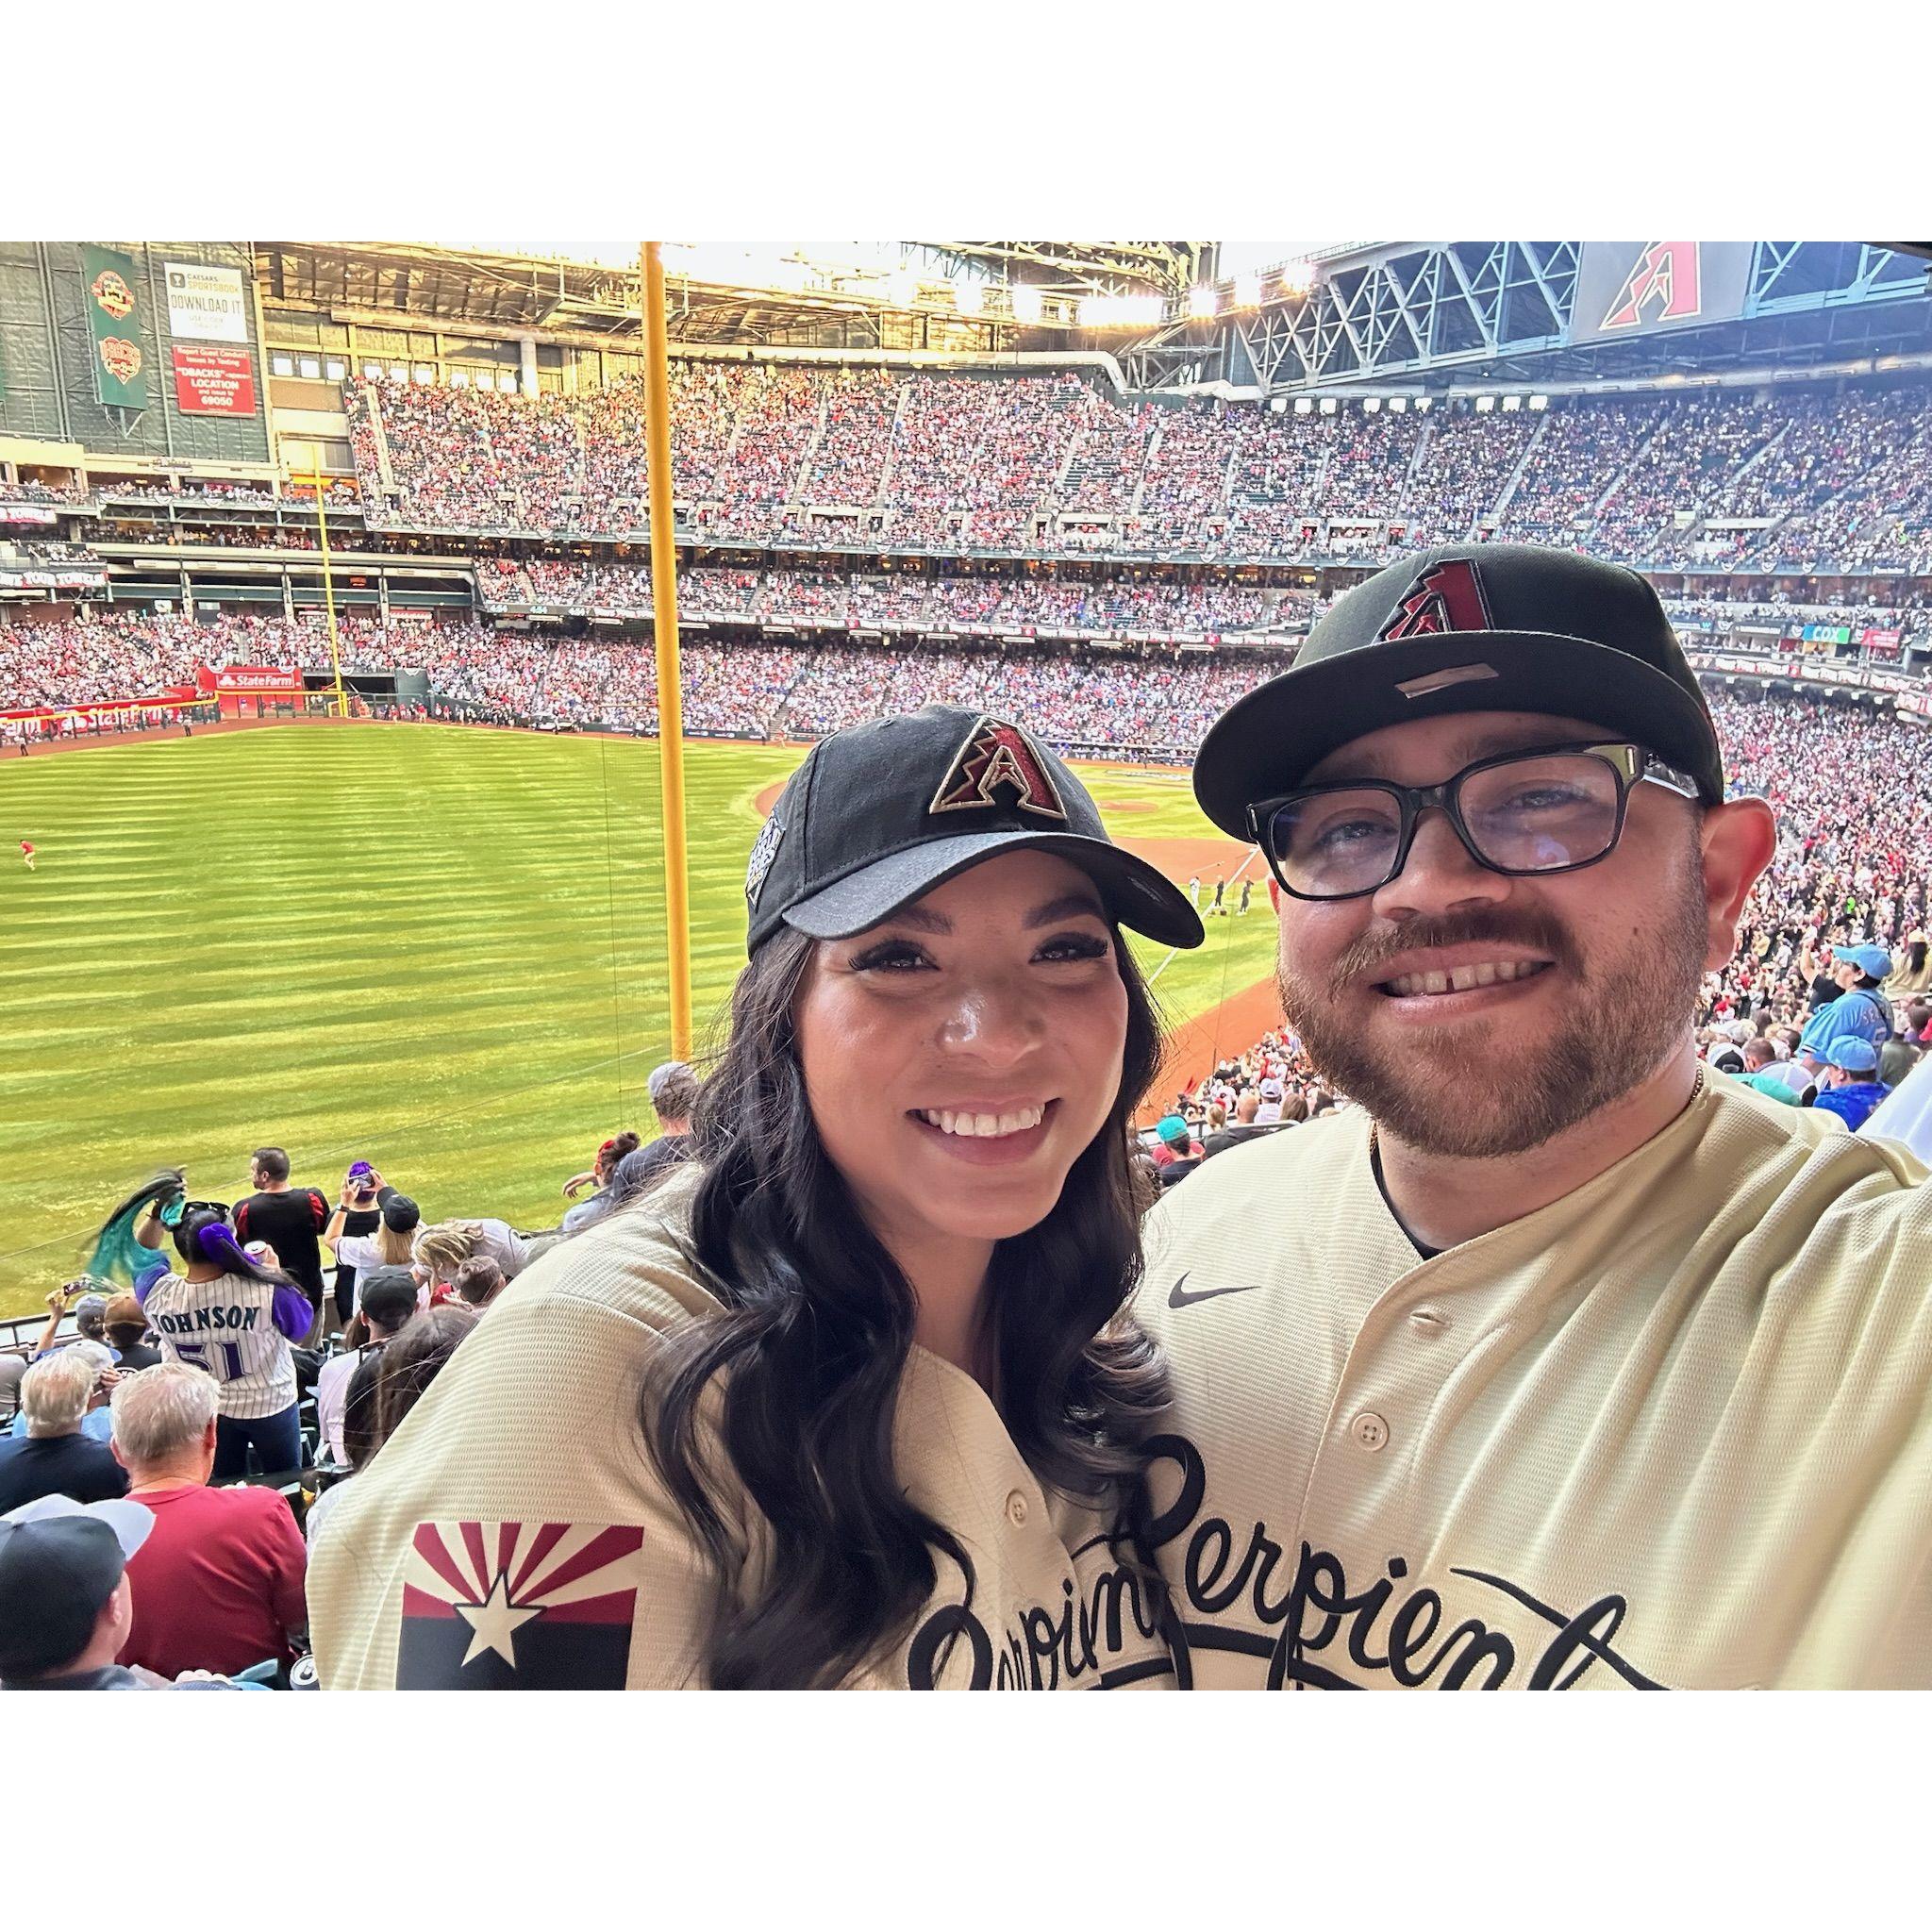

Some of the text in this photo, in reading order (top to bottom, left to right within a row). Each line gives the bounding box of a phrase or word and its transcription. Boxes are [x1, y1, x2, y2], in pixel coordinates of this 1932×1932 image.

[171, 294, 241, 314] DOWNLOAD IT
[190, 378, 240, 390] LOCATION
[200, 395, 234, 407] 69050
[1812, 625, 1840, 642] COX
[175, 1341, 253, 1384] 51
